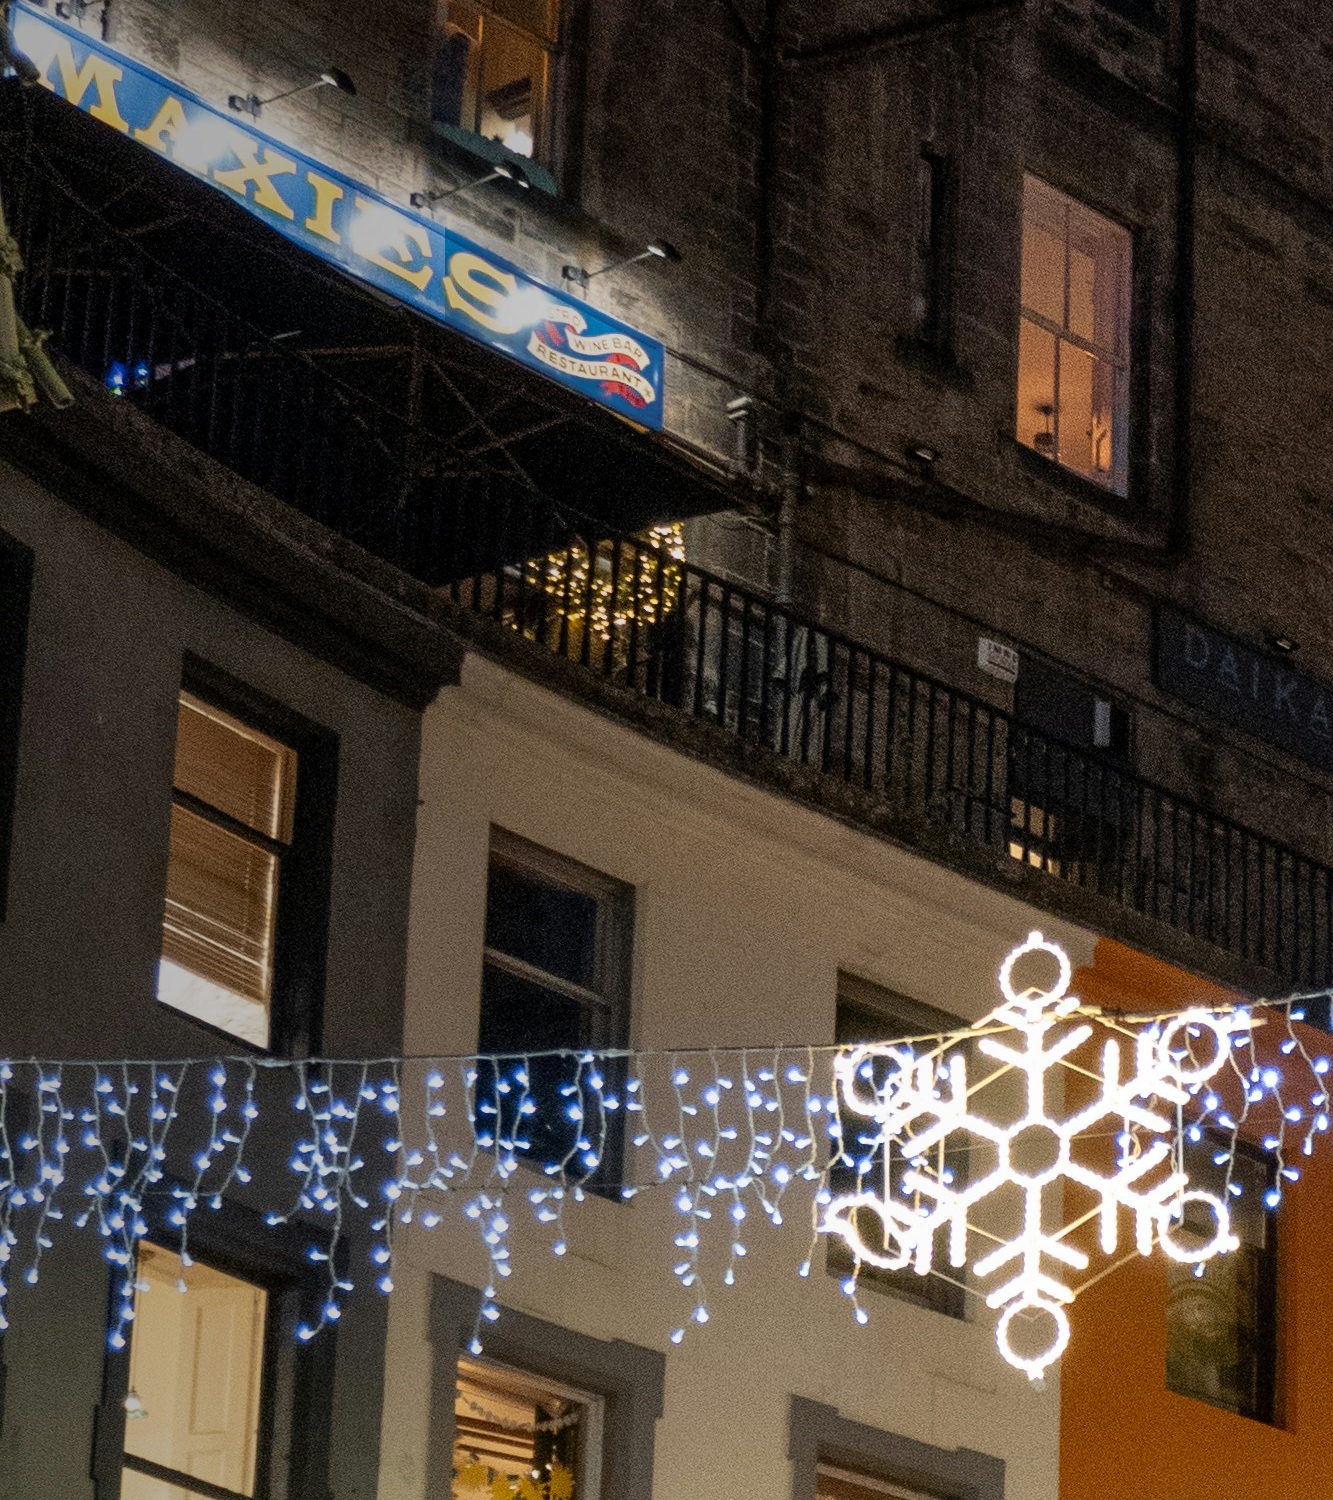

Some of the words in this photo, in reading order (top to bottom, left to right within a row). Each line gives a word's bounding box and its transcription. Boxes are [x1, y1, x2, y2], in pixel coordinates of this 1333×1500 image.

[574, 337, 609, 351] WINE
[612, 337, 643, 359] BAR
[536, 344, 642, 388] RESTAURANT
